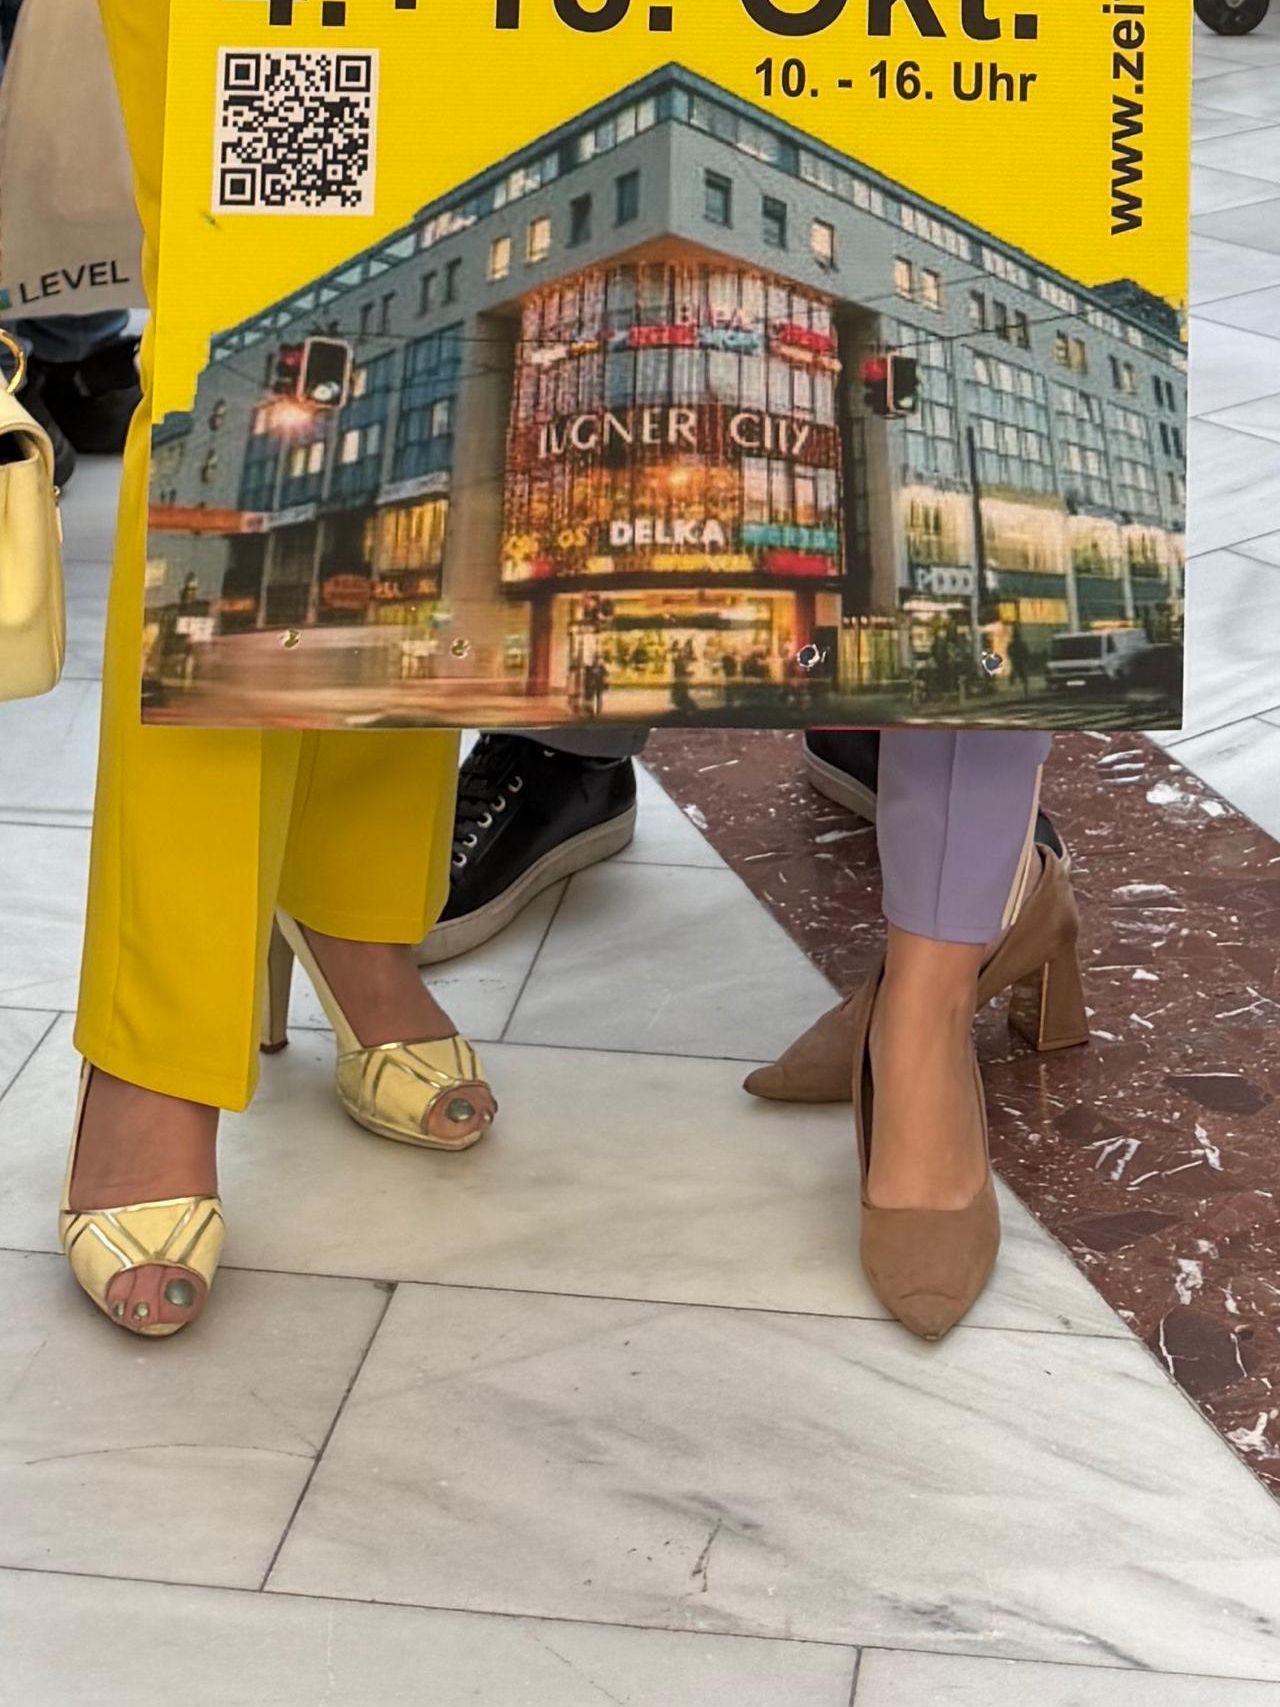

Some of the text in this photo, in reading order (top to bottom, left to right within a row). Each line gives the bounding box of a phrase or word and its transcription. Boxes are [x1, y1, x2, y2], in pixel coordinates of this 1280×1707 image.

[753, 57, 819, 99] 10.
[867, 59, 934, 101] 16.
[952, 61, 1038, 103] Uhr
[19, 259, 130, 305] LEVEL
[728, 412, 810, 456] CITY
[608, 516, 725, 548] DELKA
